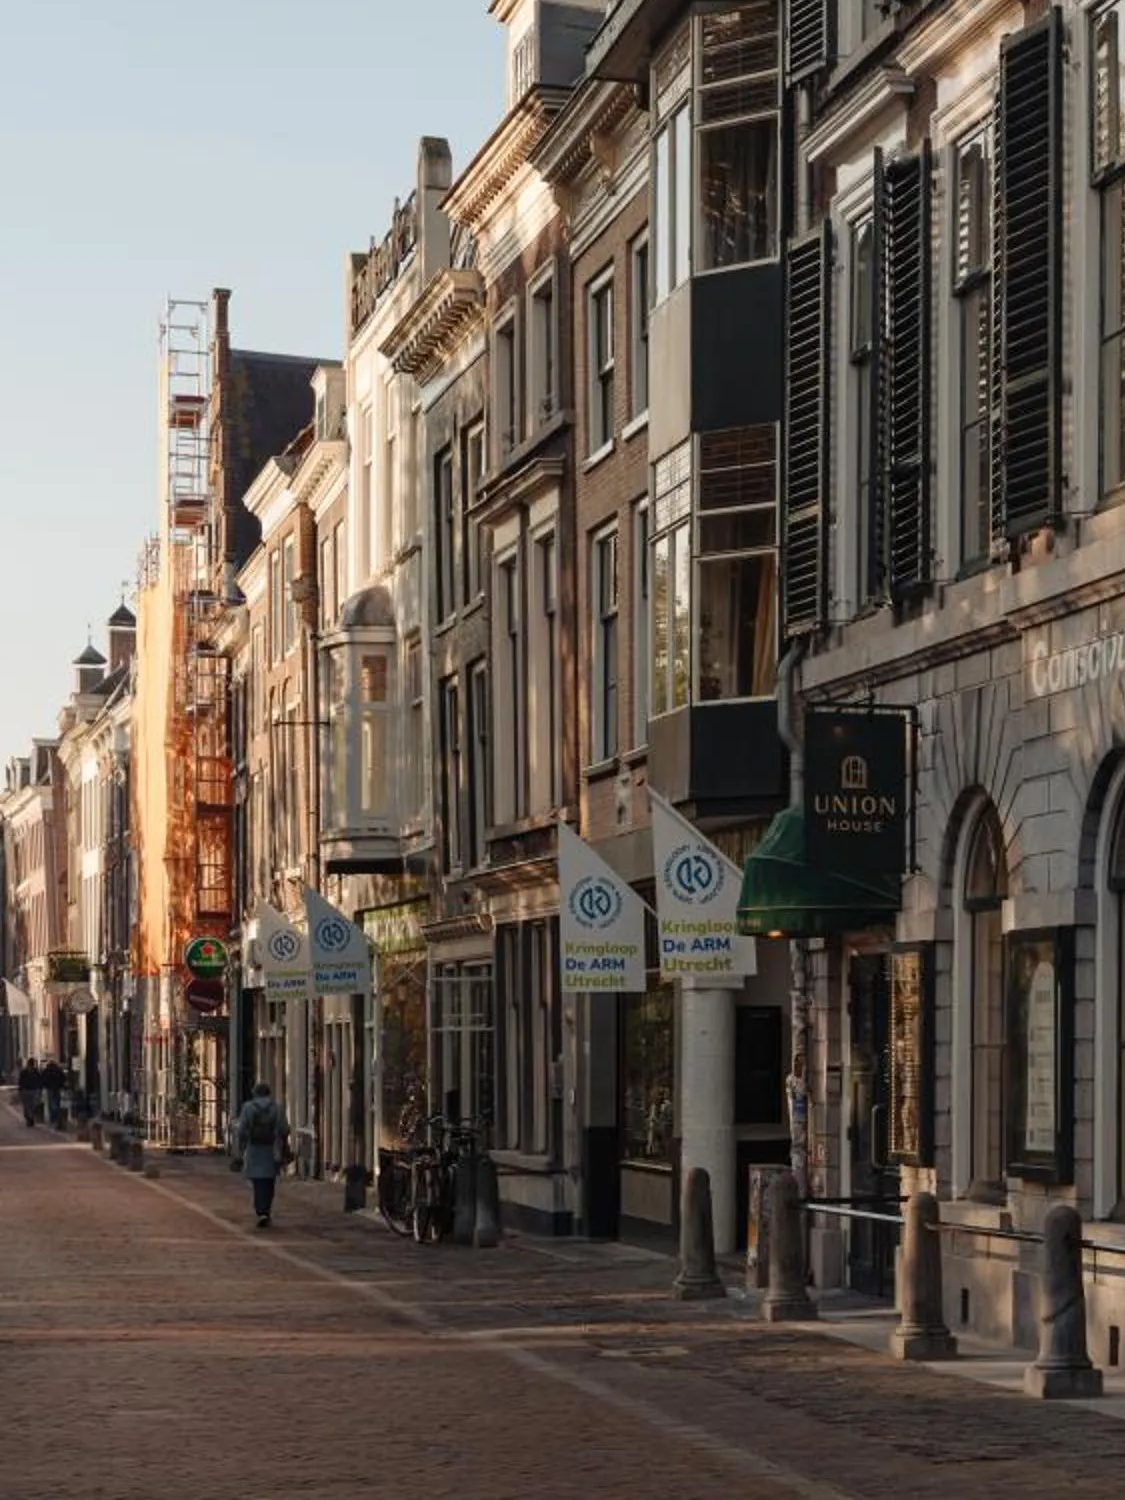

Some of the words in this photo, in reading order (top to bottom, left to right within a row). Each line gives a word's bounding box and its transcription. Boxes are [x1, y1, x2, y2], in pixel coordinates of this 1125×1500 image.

[814, 794, 896, 816] UNION
[827, 818, 883, 832] HOUSE
[565, 941, 638, 956] Kringloop
[663, 939, 686, 953] De
[691, 937, 731, 951] ARM
[565, 958, 587, 971] De
[589, 957, 626, 971] ARM
[663, 957, 734, 973] Utrecht
[564, 975, 627, 988] Utrecht
